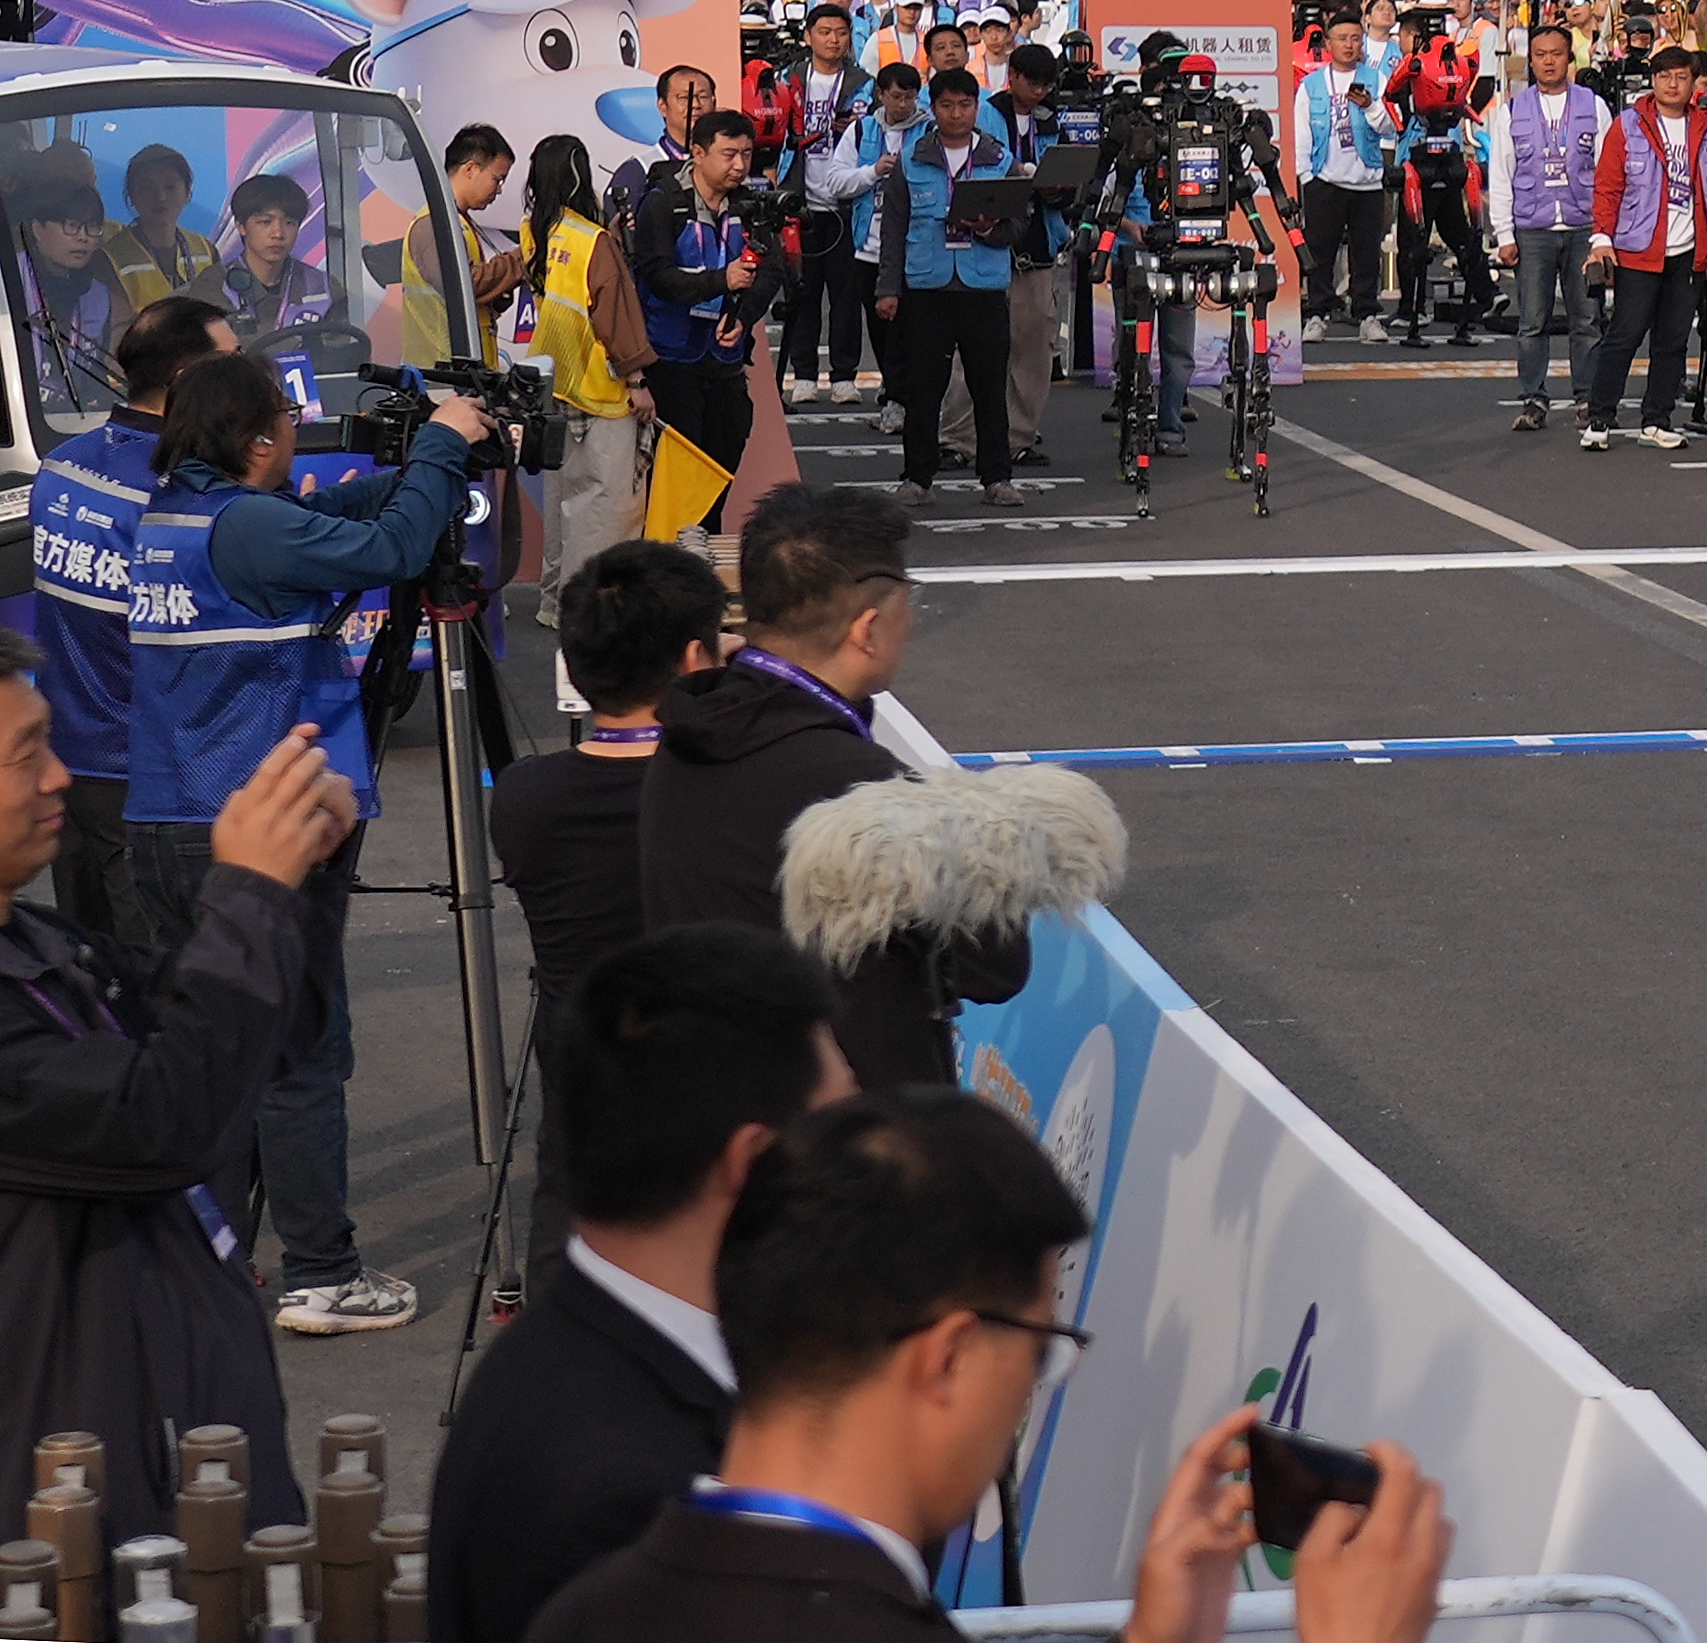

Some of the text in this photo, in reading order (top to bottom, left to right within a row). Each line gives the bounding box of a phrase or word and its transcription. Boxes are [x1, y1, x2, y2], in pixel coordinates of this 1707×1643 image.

[285, 368, 308, 406] 1
[128, 582, 199, 625] 方媒体
